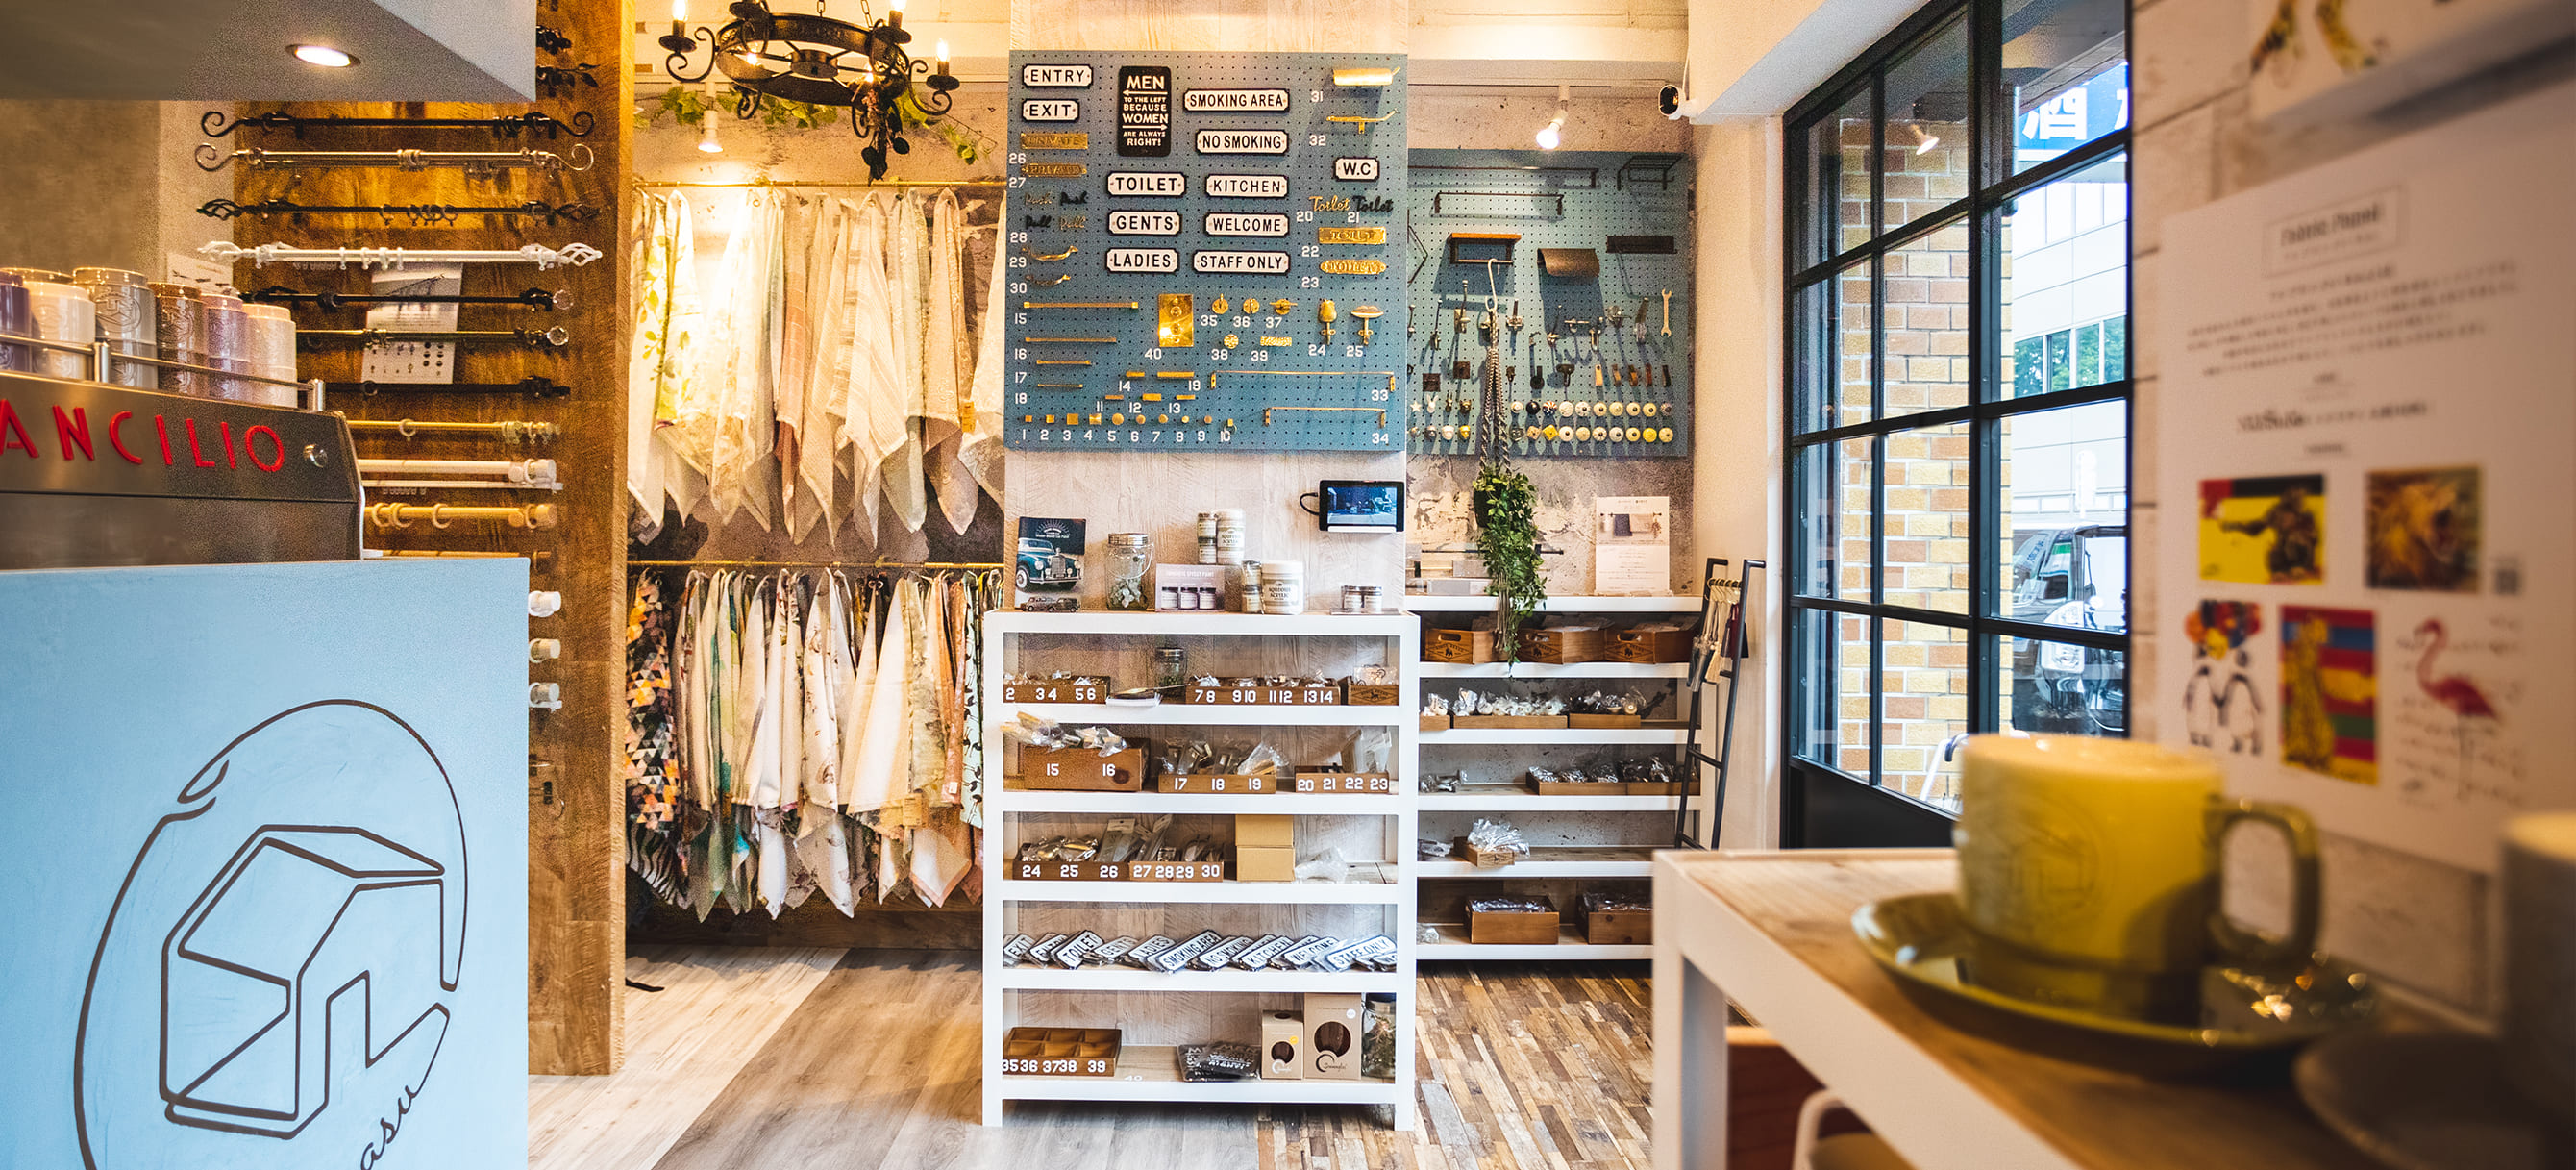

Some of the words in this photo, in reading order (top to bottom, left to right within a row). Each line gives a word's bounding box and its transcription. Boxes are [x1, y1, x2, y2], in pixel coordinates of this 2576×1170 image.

[1030, 69, 1085, 83] ENTRY
[1126, 75, 1165, 90] MEN
[1189, 94, 1247, 107] SMOKING
[1251, 94, 1283, 107] AREA
[1310, 91, 1324, 103] 31
[1029, 104, 1072, 116] EXIT
[1124, 103, 1167, 112] BECAUSE
[1122, 112, 1169, 124] WOMEN
[1202, 135, 1220, 148] NO
[1224, 135, 1281, 148] SMOKING
[1309, 135, 1326, 146] 32
[1008, 153, 1027, 164] 26
[1343, 162, 1372, 176] W.C
[1008, 178, 1027, 189] 27
[1115, 177, 1177, 191] TOILET
[1213, 180, 1281, 192] KITCHEN
[1308, 194, 1350, 212] Toilet
[1351, 195, 1394, 212] Toilet
[1116, 215, 1174, 231] GENTS
[1297, 211, 1313, 222] 20
[1347, 212, 1360, 223] 21
[1213, 217, 1281, 231] WELCOME
[1009, 232, 1028, 243] 28
[1301, 246, 1320, 257] 22
[1009, 257, 1027, 268] 29
[1113, 253, 1171, 267] LADIES
[1201, 255, 1243, 268] STAFF
[1247, 256, 1282, 269] ONLY
[1009, 283, 1028, 293] 30
[1301, 277, 1320, 288] 23
[1014, 313, 1027, 324] 15
[1201, 315, 1218, 327] 35
[1232, 316, 1251, 328] 36
[1265, 317, 1282, 329] 37
[1014, 348, 1027, 360] 16
[1144, 348, 1162, 361] 40
[1211, 349, 1228, 361] 38
[1251, 351, 1268, 362] 39
[1308, 344, 1326, 356] 24
[1346, 345, 1364, 358] 25
[1014, 372, 1028, 383] 17
[1119, 380, 1131, 392] 14
[1188, 380, 1201, 391] 19
[1014, 392, 1028, 404] 18
[1371, 389, 1389, 401] 33
[1096, 401, 1103, 412] 11
[1129, 402, 1142, 413] 12
[1169, 403, 1181, 414] 13
[0, 399, 285, 473] ANCILIO
[1022, 429, 1026, 440] 1
[1040, 430, 1049, 441] 2
[1063, 430, 1072, 441] 3
[1083, 429, 1093, 440] 4
[1107, 430, 1116, 442] 5
[1130, 431, 1139, 442] 6
[1152, 431, 1161, 442] 7
[1176, 431, 1184, 442] 8
[1197, 431, 1205, 441] 9
[1220, 431, 1231, 442] 10
[1372, 433, 1389, 444] 34
[1005, 688, 1015, 700] 2
[1035, 688, 1045, 700] 3
[1048, 688, 1057, 700] 4
[1075, 688, 1084, 700] 5
[1086, 688, 1096, 700] 6
[1195, 690, 1204, 702] 7
[1206, 690, 1216, 703] 8
[1232, 690, 1242, 702] 9
[1244, 690, 1256, 703] 10
[1269, 690, 1277, 703] 11
[1279, 690, 1293, 703] 12
[1304, 690, 1318, 703] 13
[1320, 690, 1333, 703] 14
[1046, 763, 1059, 776] 15
[1102, 763, 1115, 776] 16
[1175, 778, 1187, 790] 17
[1211, 778, 1225, 790] 18
[1249, 778, 1261, 790] 19
[1298, 779, 1314, 792] 20
[1323, 778, 1336, 790] 21
[1346, 777, 1363, 790] 22
[1370, 778, 1388, 790] 23
[1022, 864, 1041, 877] 24
[1060, 864, 1078, 877] 25
[1100, 865, 1118, 878] 26
[1133, 864, 1152, 877] 27
[1155, 865, 1174, 878] 28
[1176, 865, 1194, 879] 29
[1201, 864, 1220, 877] 30
[1008, 937, 1031, 957] EXIT
[1063, 934, 1099, 961] TOILET
[1163, 942, 1201, 967] SMOKING
[1200, 934, 1219, 950] AREA
[1249, 939, 1290, 964] KITCHEN
[1363, 939, 1388, 957] ONLY
[1206, 952, 1222, 964] NO
[1003, 1058, 1019, 1072] 35
[1020, 1059, 1038, 1073] 36
[1043, 1060, 1059, 1074] 37
[1059, 1059, 1077, 1073] 38
[1087, 1060, 1106, 1073] 39
